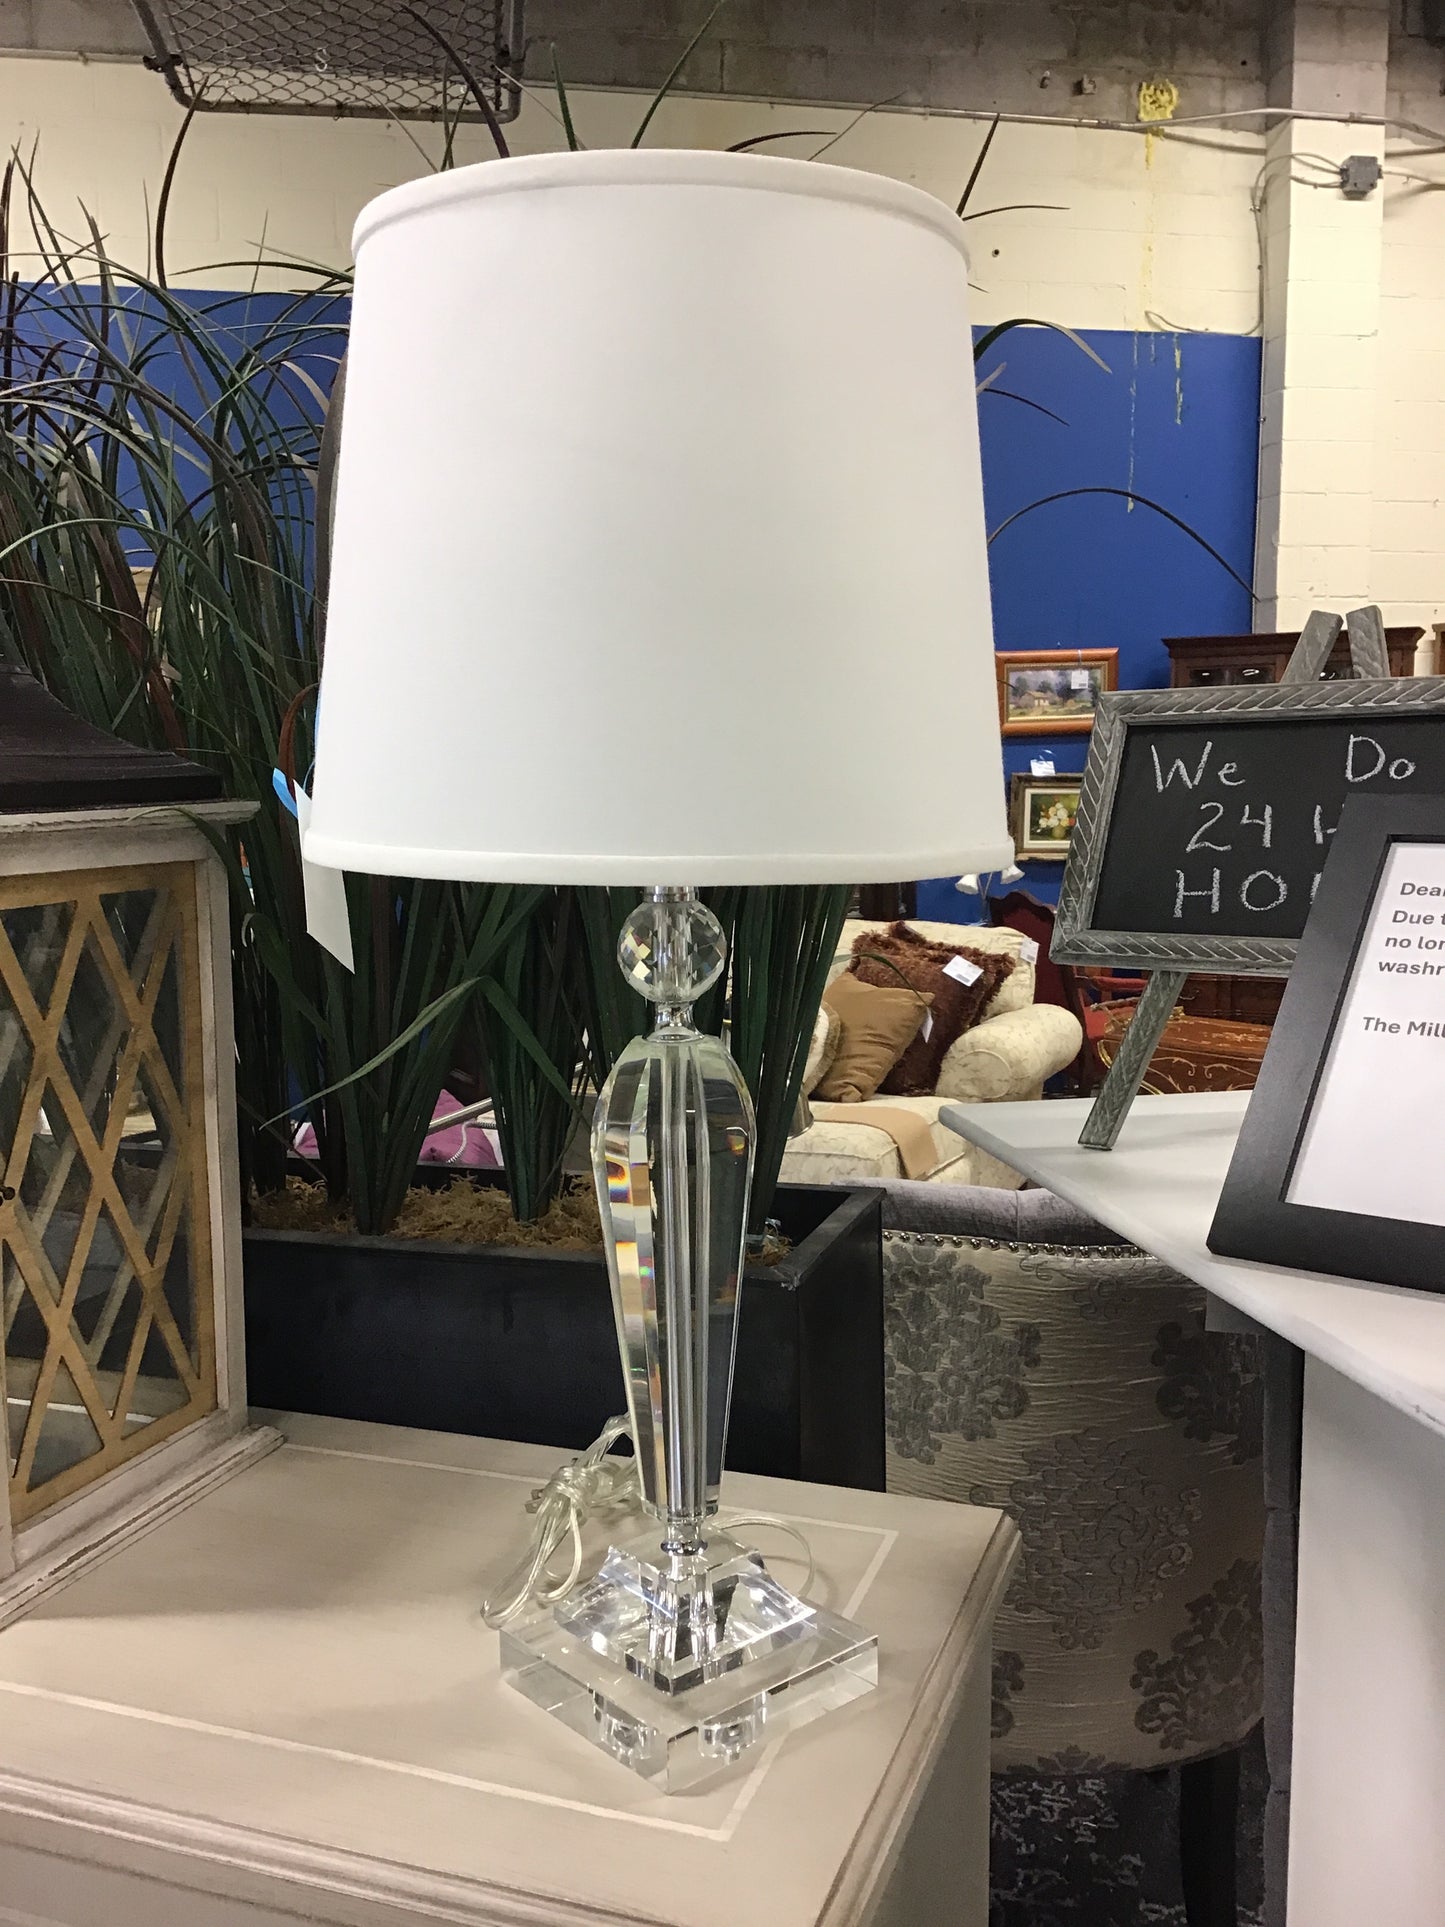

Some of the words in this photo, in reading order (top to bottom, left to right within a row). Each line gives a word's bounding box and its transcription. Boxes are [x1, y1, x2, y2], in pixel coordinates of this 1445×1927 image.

[1150, 740, 1246, 794] We
[1344, 733, 1418, 783] Do
[1185, 801, 1274, 854] 24
[1392, 910, 1435, 925] Due
[1385, 936, 1412, 949] no
[1363, 1016, 1401, 1034] The
